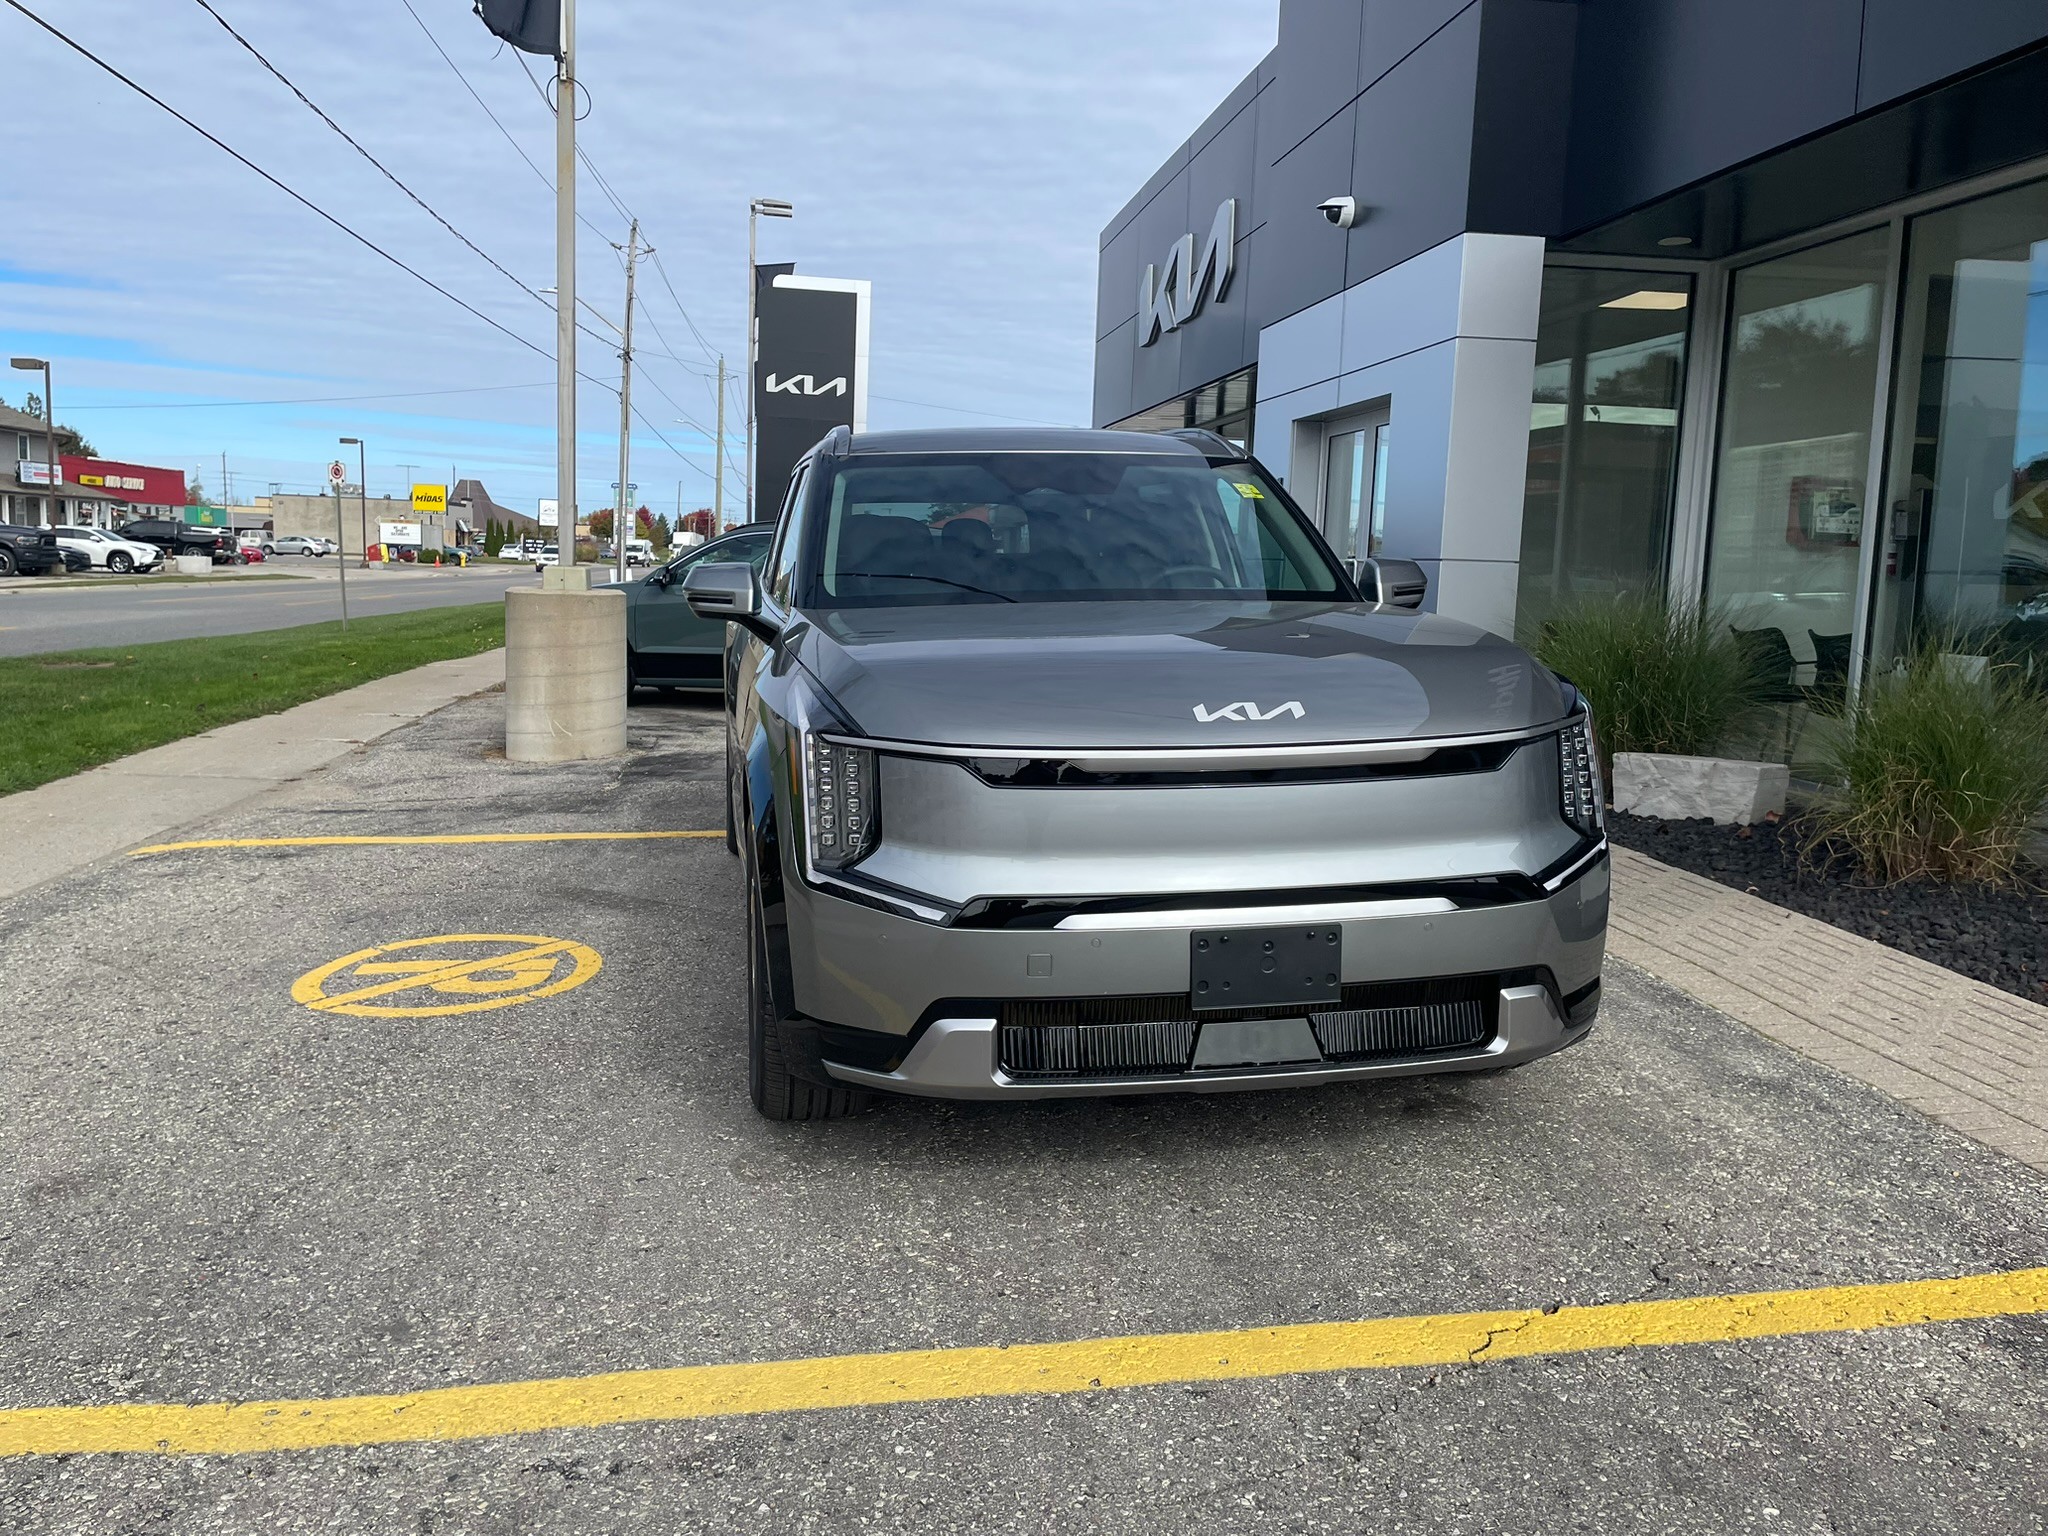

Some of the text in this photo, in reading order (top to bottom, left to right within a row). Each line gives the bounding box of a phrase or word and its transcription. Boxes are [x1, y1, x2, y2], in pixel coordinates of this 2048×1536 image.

[1138, 198, 1236, 348] KIA
[766, 372, 847, 397] KIA
[415, 492, 444, 503] MIDAS
[1192, 701, 1306, 722] KIA
